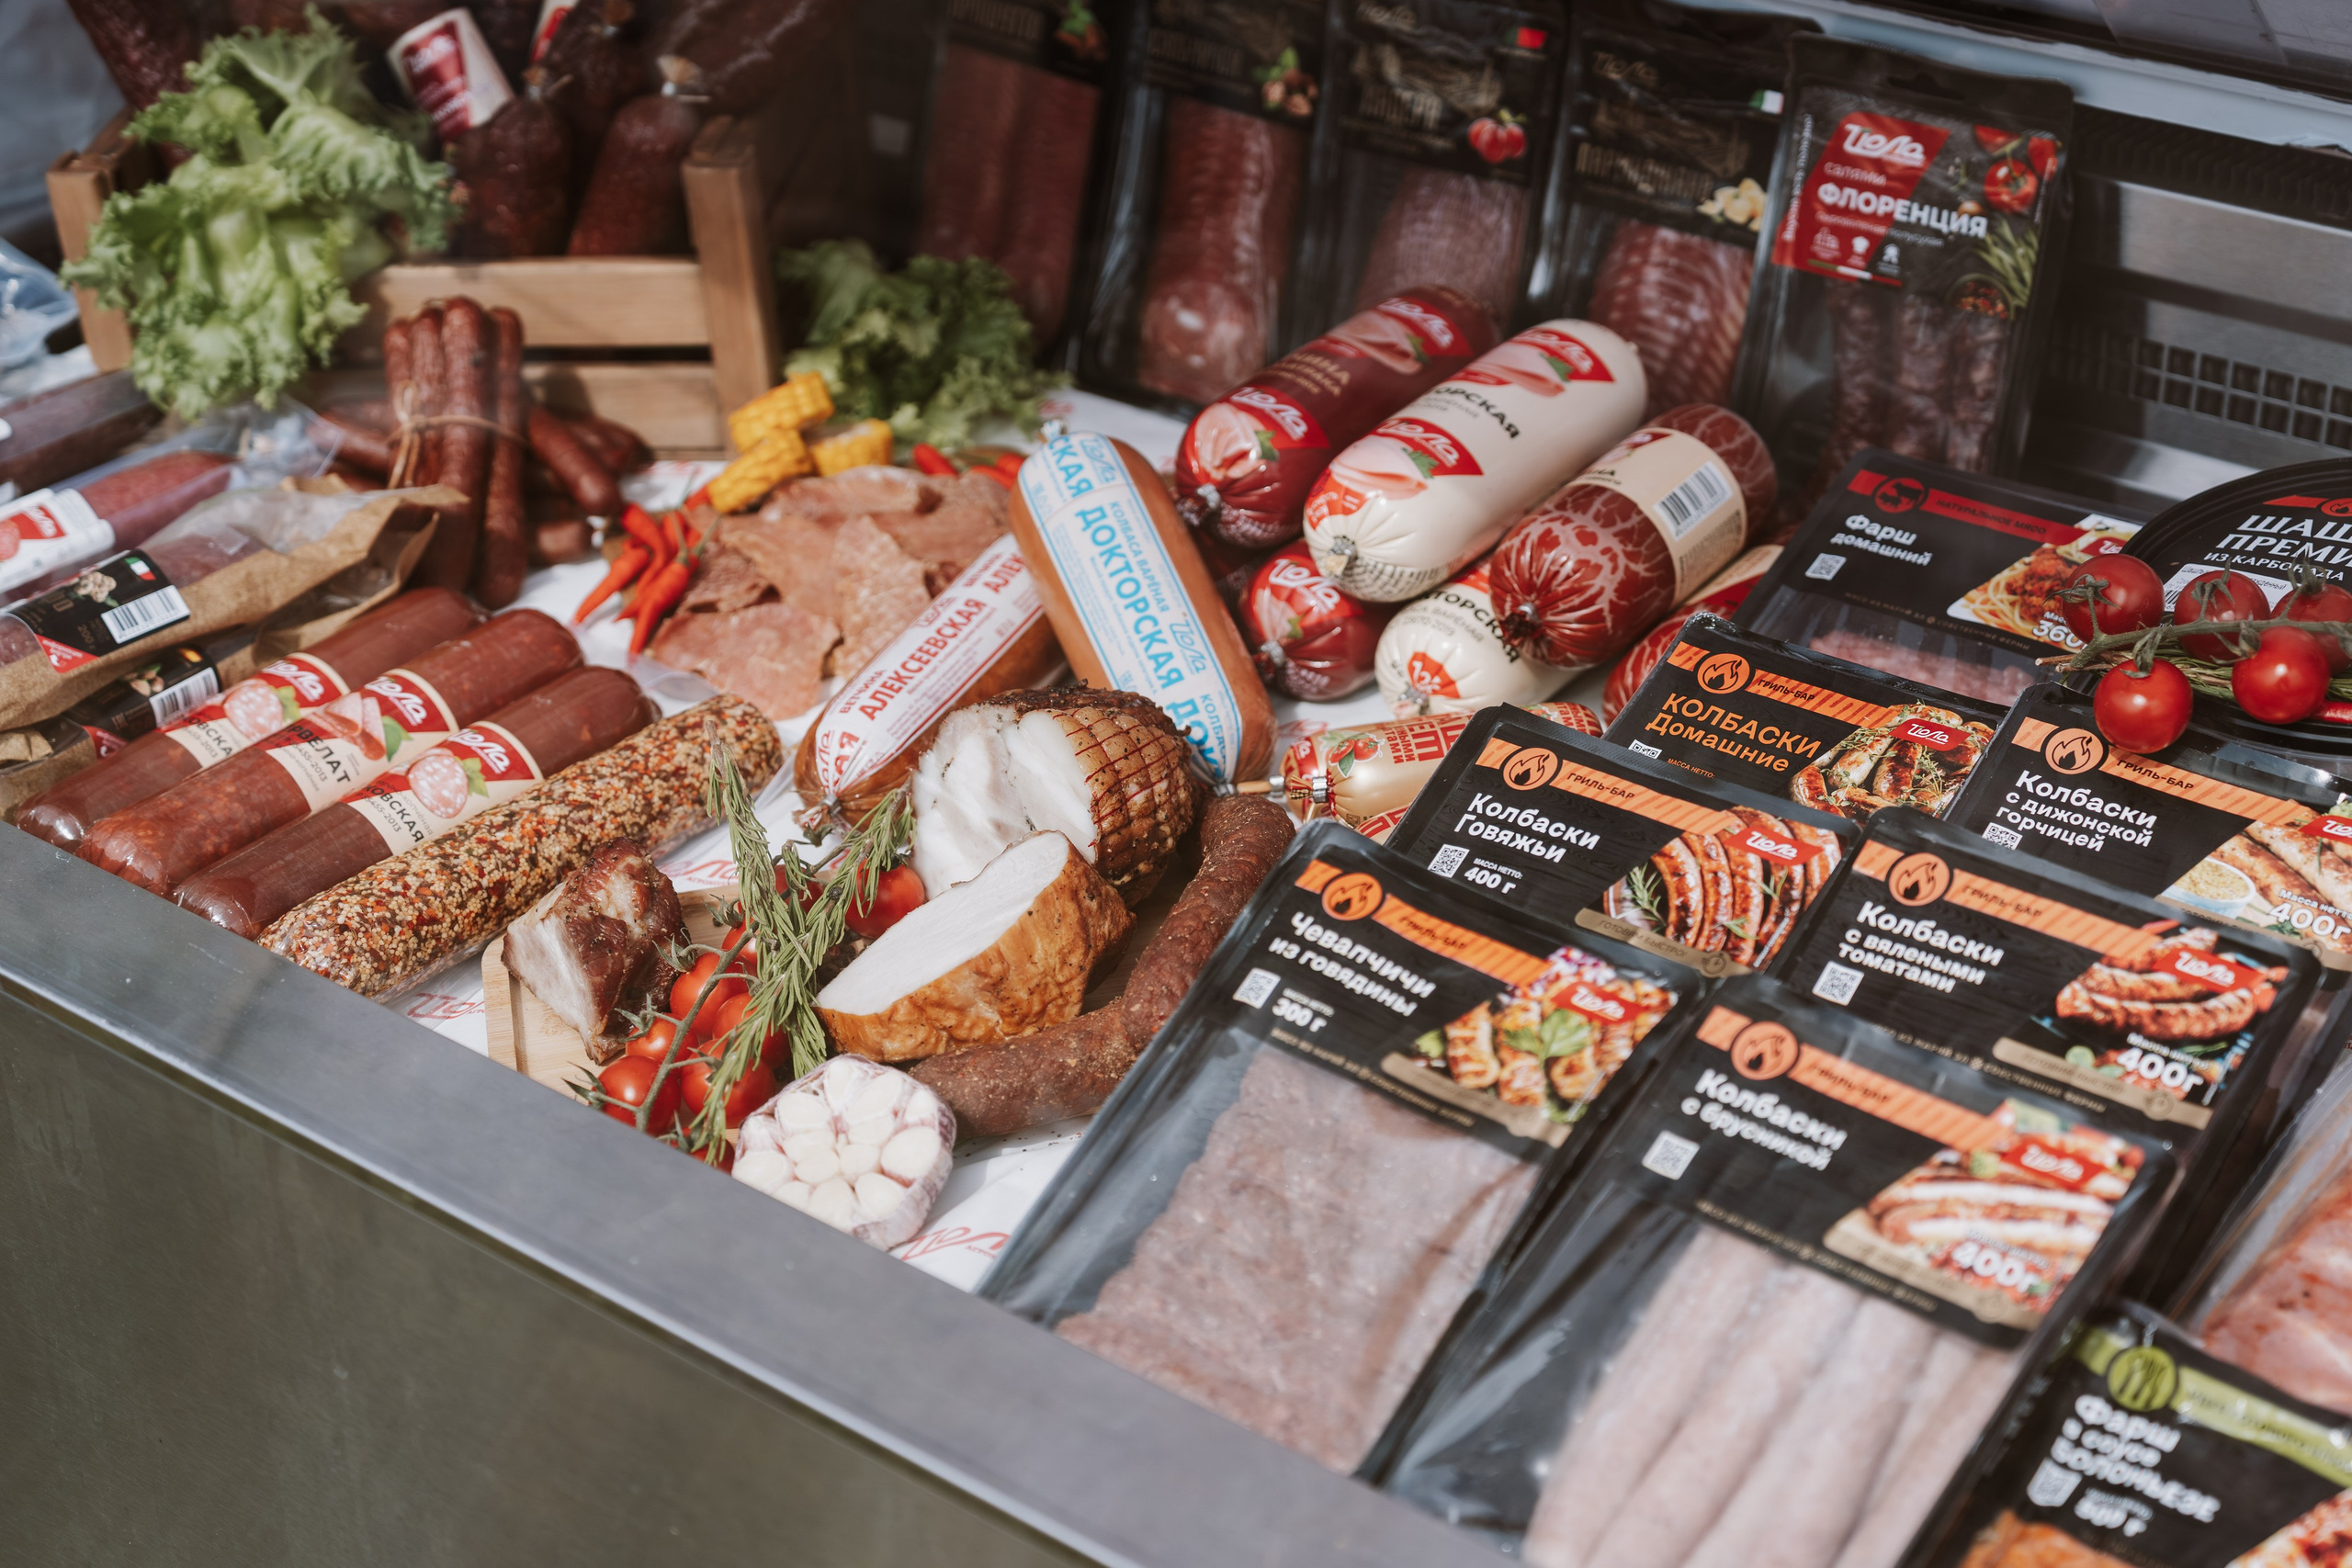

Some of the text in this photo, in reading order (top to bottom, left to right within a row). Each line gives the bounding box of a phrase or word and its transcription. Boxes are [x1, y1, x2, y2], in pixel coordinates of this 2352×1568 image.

[1817, 182, 1988, 239] ФЛОРЕНЦИЯ
[1432, 385, 1521, 439] ОРСКАЯ
[1048, 435, 1093, 498] СКАЯ
[1831, 532, 1933, 566] домашний
[1845, 514, 1917, 546] Фарш
[2215, 534, 2352, 567] ПРЕМИ
[2237, 515, 2352, 543] ШАШ
[983, 552, 1026, 593] АЛЕК
[1109, 502, 1170, 614] КОЛБАСА ВАРЁНАЯ
[2204, 552, 2229, 561] ИЗ
[1076, 506, 1185, 690] ДОКТОРСКАЯ
[1429, 590, 1520, 663] ТОРСКАЯ
[2032, 619, 2086, 649] 360
[858, 598, 988, 721] АЛЕКСЕЕВСКАЯ
[840, 669, 887, 714] ВЕТЧИНА
[1758, 679, 1815, 702] ГРИЛЬ-БАР
[187, 714, 233, 756] ОВСКА
[1166, 698, 1223, 777] ДОК
[1200, 694, 1227, 759] КОЛБАС
[1645, 712, 1789, 772] Домашние
[1662, 693, 1822, 758] КОЛБАСКИ
[286, 724, 352, 784] РВЕЛАТ
[1668, 758, 1715, 779] МАССА НЕТТО:
[2117, 760, 2194, 790] ГРИЛЬ-БАР
[1566, 773, 1634, 799] ГРИЛЬ-БАР
[2015, 770, 2157, 829] Колбаски
[365, 784, 425, 842] КОВСКАЯ
[1453, 814, 1566, 863] Говяжьи
[1467, 793, 1600, 850] Колбаски
[1996, 807, 2106, 852] горчицей
[2006, 792, 2154, 848] с дижонской
[1464, 866, 1516, 894] 400 г
[1474, 857, 1523, 879] МАССА НЕТТО:
[1962, 886, 2043, 918] ГРИЛЬ-БАР
[2270, 902, 2352, 940] 400г
[2278, 889, 2318, 908] Масса
[1291, 911, 1437, 998] Чевапчичи
[1600, 919, 1688, 957] ГОТОВИМ БЫСТРО!
[1845, 929, 1986, 985] с вялеными
[1856, 900, 2005, 966] Колбаски
[1269, 937, 1419, 1017] из говядины
[1838, 942, 1957, 994] томатами
[1272, 998, 1313, 1027] 300
[2117, 1046, 2204, 1092] 400г
[1681, 1097, 1833, 1171] с брусникой
[1694, 1068, 1848, 1151] Колбаски
[1951, 1241, 2041, 1292] 400г
[2075, 1394, 2181, 1453] Фарш
